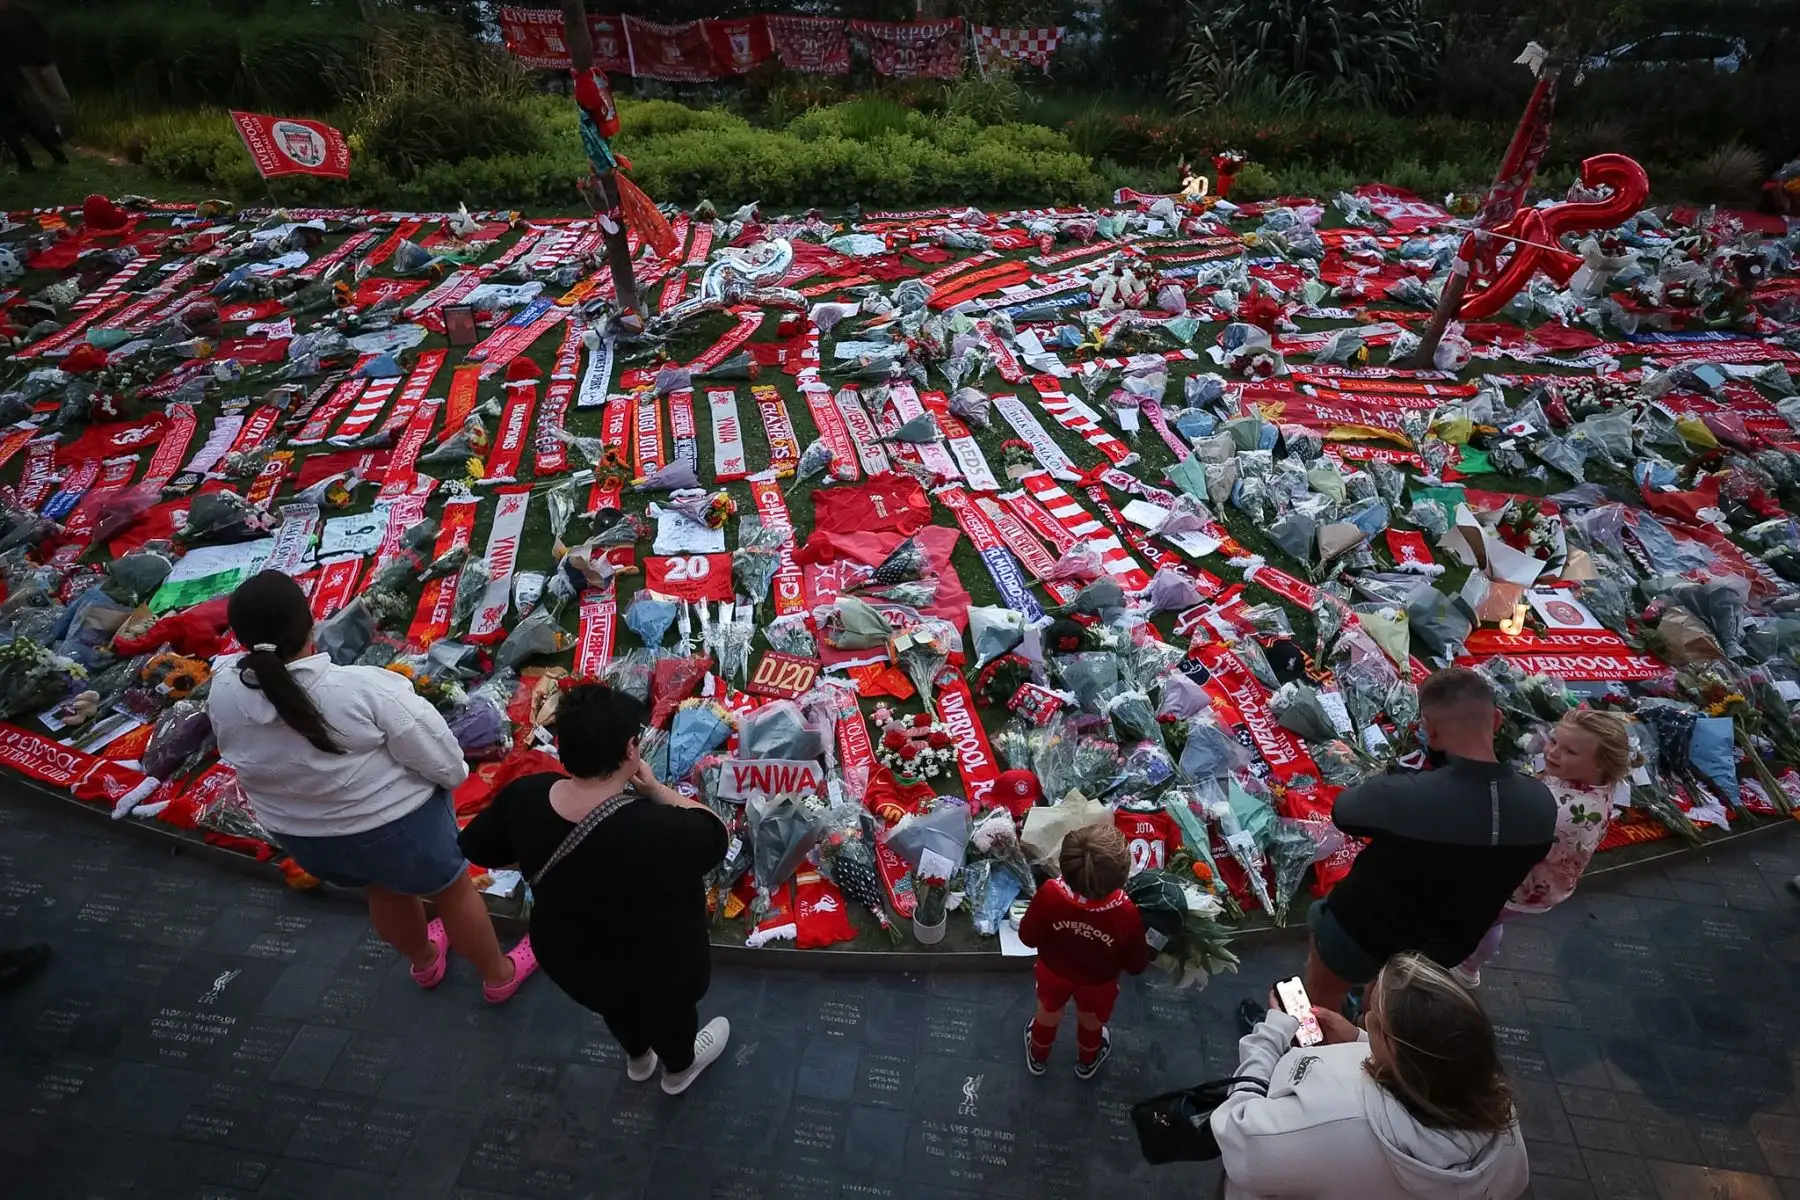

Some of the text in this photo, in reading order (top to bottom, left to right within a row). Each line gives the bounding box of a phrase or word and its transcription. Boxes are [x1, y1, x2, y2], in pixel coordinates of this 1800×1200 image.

[504, 12, 566, 25] LIVERPO
[240, 116, 275, 170] LIVERPOOL
[1180, 176, 1208, 198] 20
[245, 416, 271, 440] JOTA
[716, 416, 738, 444] YNWA
[639, 435, 658, 460] JOTA
[865, 446, 881, 459] FC
[955, 440, 985, 477] REDS
[490, 535, 517, 581] YNWA
[664, 555, 710, 582] 20
[987, 550, 1024, 600] R.MADRID
[585, 616, 607, 680] LIVERPOO
[753, 657, 816, 693] DJ20
[1509, 656, 1660, 671] IVERPOOL FC
[1556, 671, 1590, 679] NEVER
[1595, 671, 1624, 679] WALK
[1210, 655, 1290, 765] LIVERPOOL FC
[846, 719, 863, 755] YOU'LL
[941, 692, 989, 774] LIVERPOOL
[1275, 732, 1299, 762] YOU'LL
[0, 728, 83, 774] IVERPOOL
[0, 744, 71, 782] OTBALL CLUB
[732, 764, 817, 794] YNWA
[1136, 823, 1155, 834] JOTA
[1052, 920, 1116, 948] LIVERPOOL
[1074, 928, 1095, 941] F.C.
